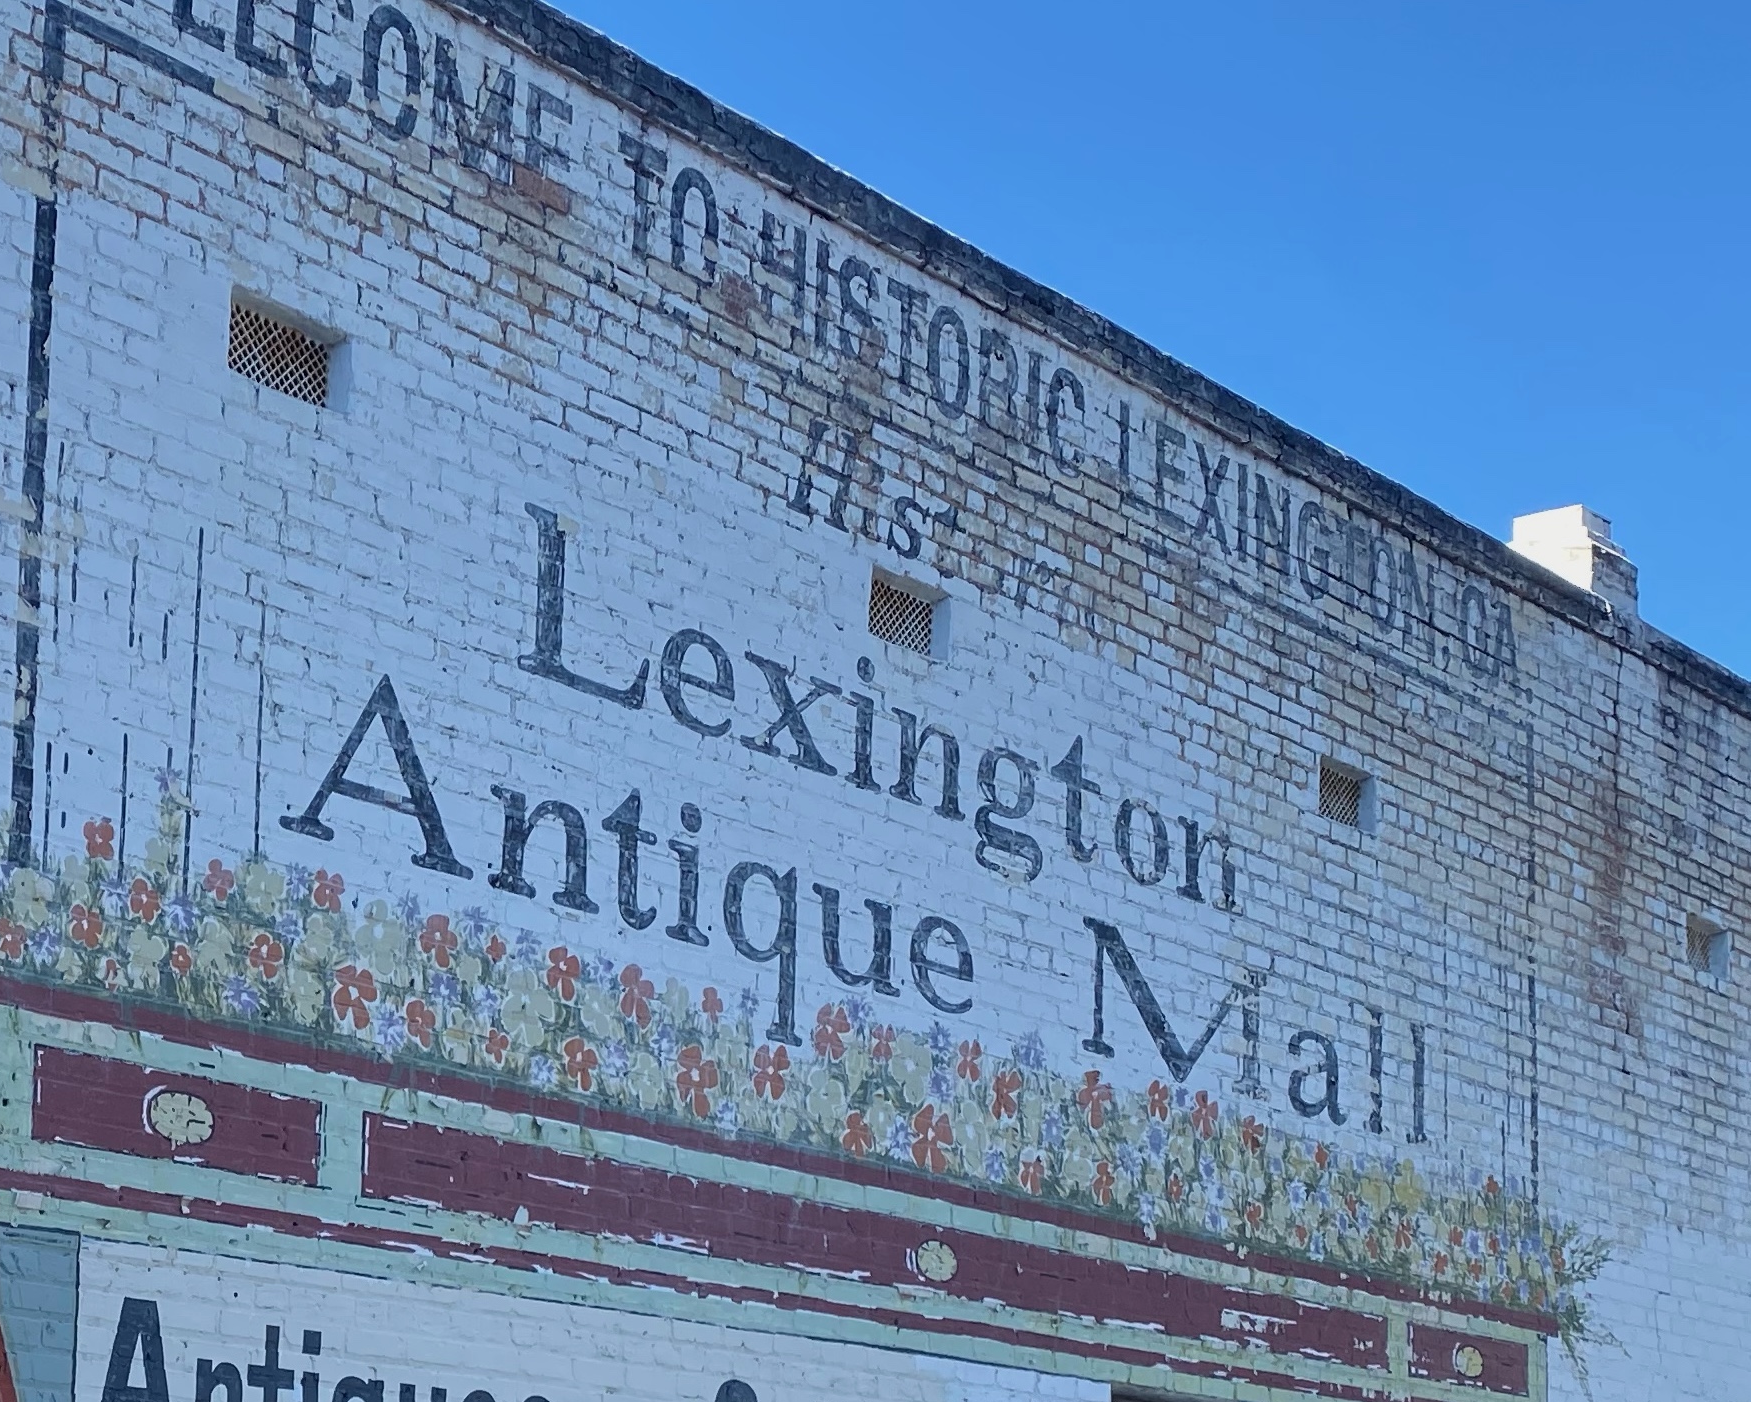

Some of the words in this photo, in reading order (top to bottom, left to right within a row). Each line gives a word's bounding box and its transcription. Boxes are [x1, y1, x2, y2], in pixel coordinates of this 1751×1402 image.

[617, 131, 721, 288] TO
[761, 208, 1086, 479] HISTORIC
[279, 674, 975, 1046] Antique
[1083, 916, 1427, 1143] Mall
[517, 501, 1241, 912] Lexington
